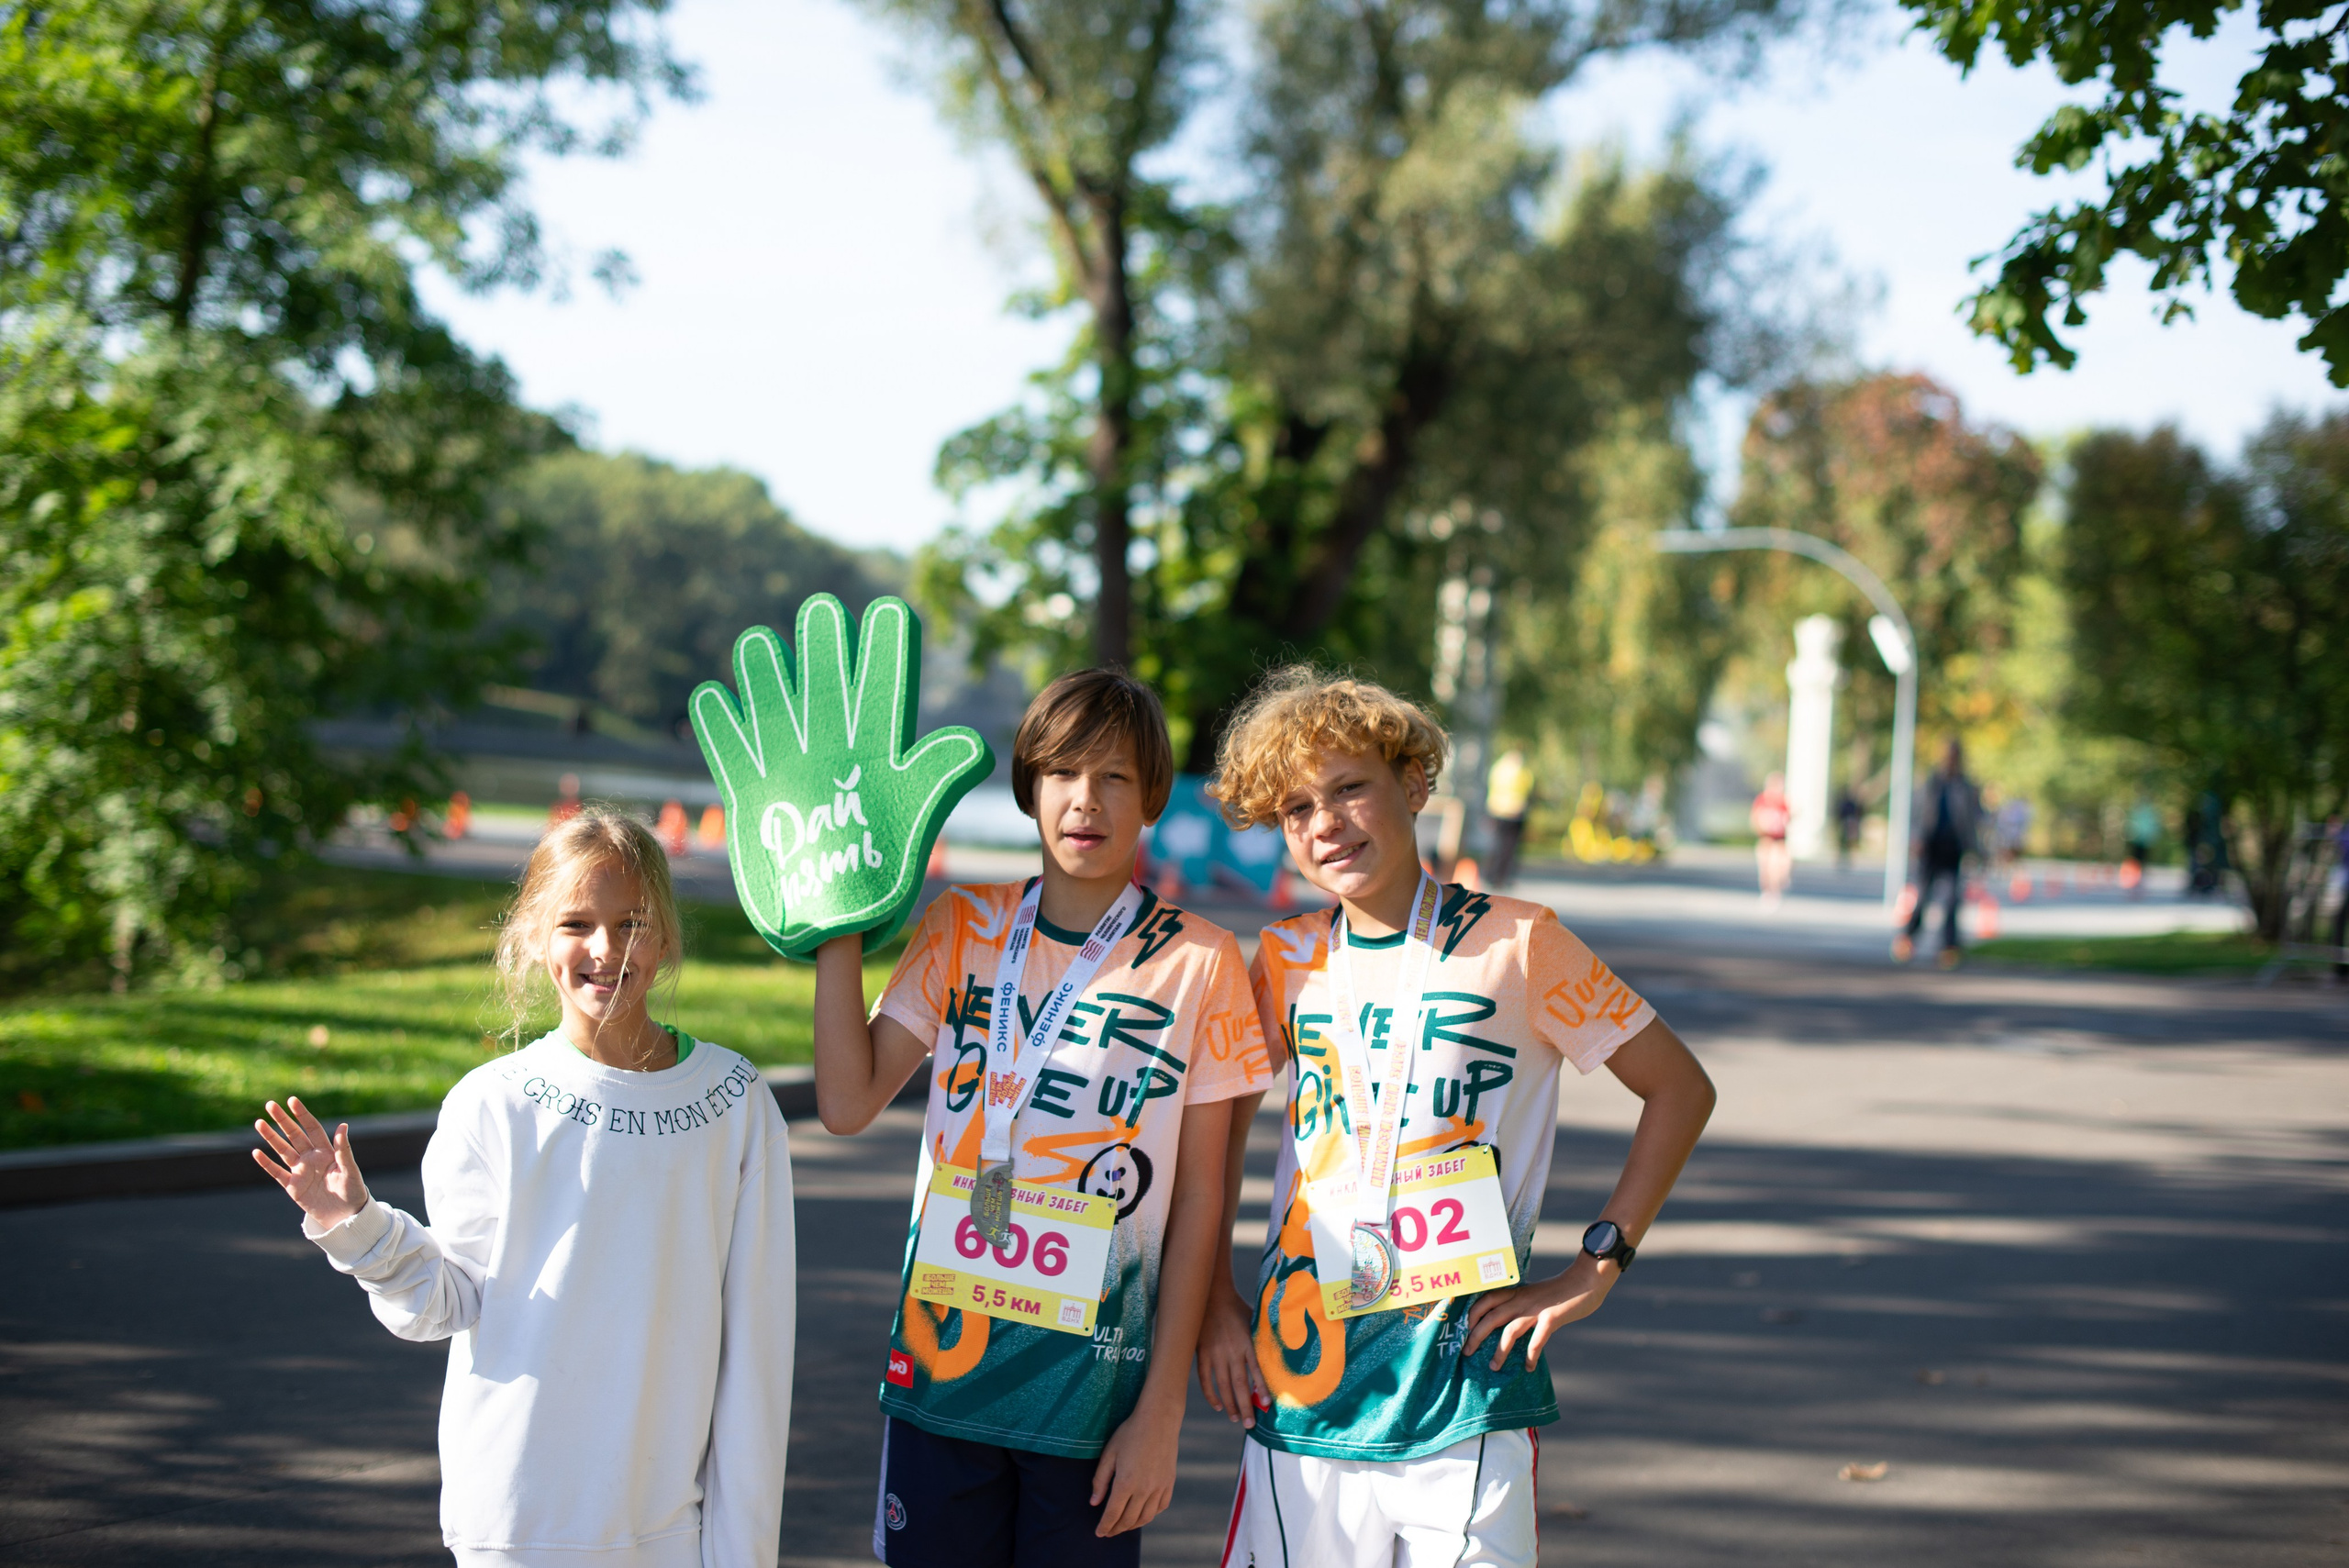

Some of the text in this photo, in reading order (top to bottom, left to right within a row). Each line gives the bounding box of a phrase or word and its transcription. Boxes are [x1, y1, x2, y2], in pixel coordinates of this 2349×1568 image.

[1095, 915, 1112, 936] РАЗВИТИЕ
[1100, 906, 1126, 940] ЧЕЛОВЕЧЕСКОГО
[1106, 922, 1122, 942] КАПИТАЛА
[996, 982, 1016, 1052] ФЕНИКС
[1031, 983, 1074, 1047] ФЕНИКС
[523, 1077, 602, 1126] CROIS
[609, 1107, 646, 1136] EN
[655, 1101, 709, 1136] MON
[1098, 1066, 1179, 1129] UP
[1433, 1060, 1513, 1127] UP
[1429, 1158, 1465, 1177] ЗАБЕГ
[1048, 1196, 1089, 1214] ЗАБЕГ
[955, 1215, 1070, 1276] 606
[973, 1284, 1006, 1308] 5,5
